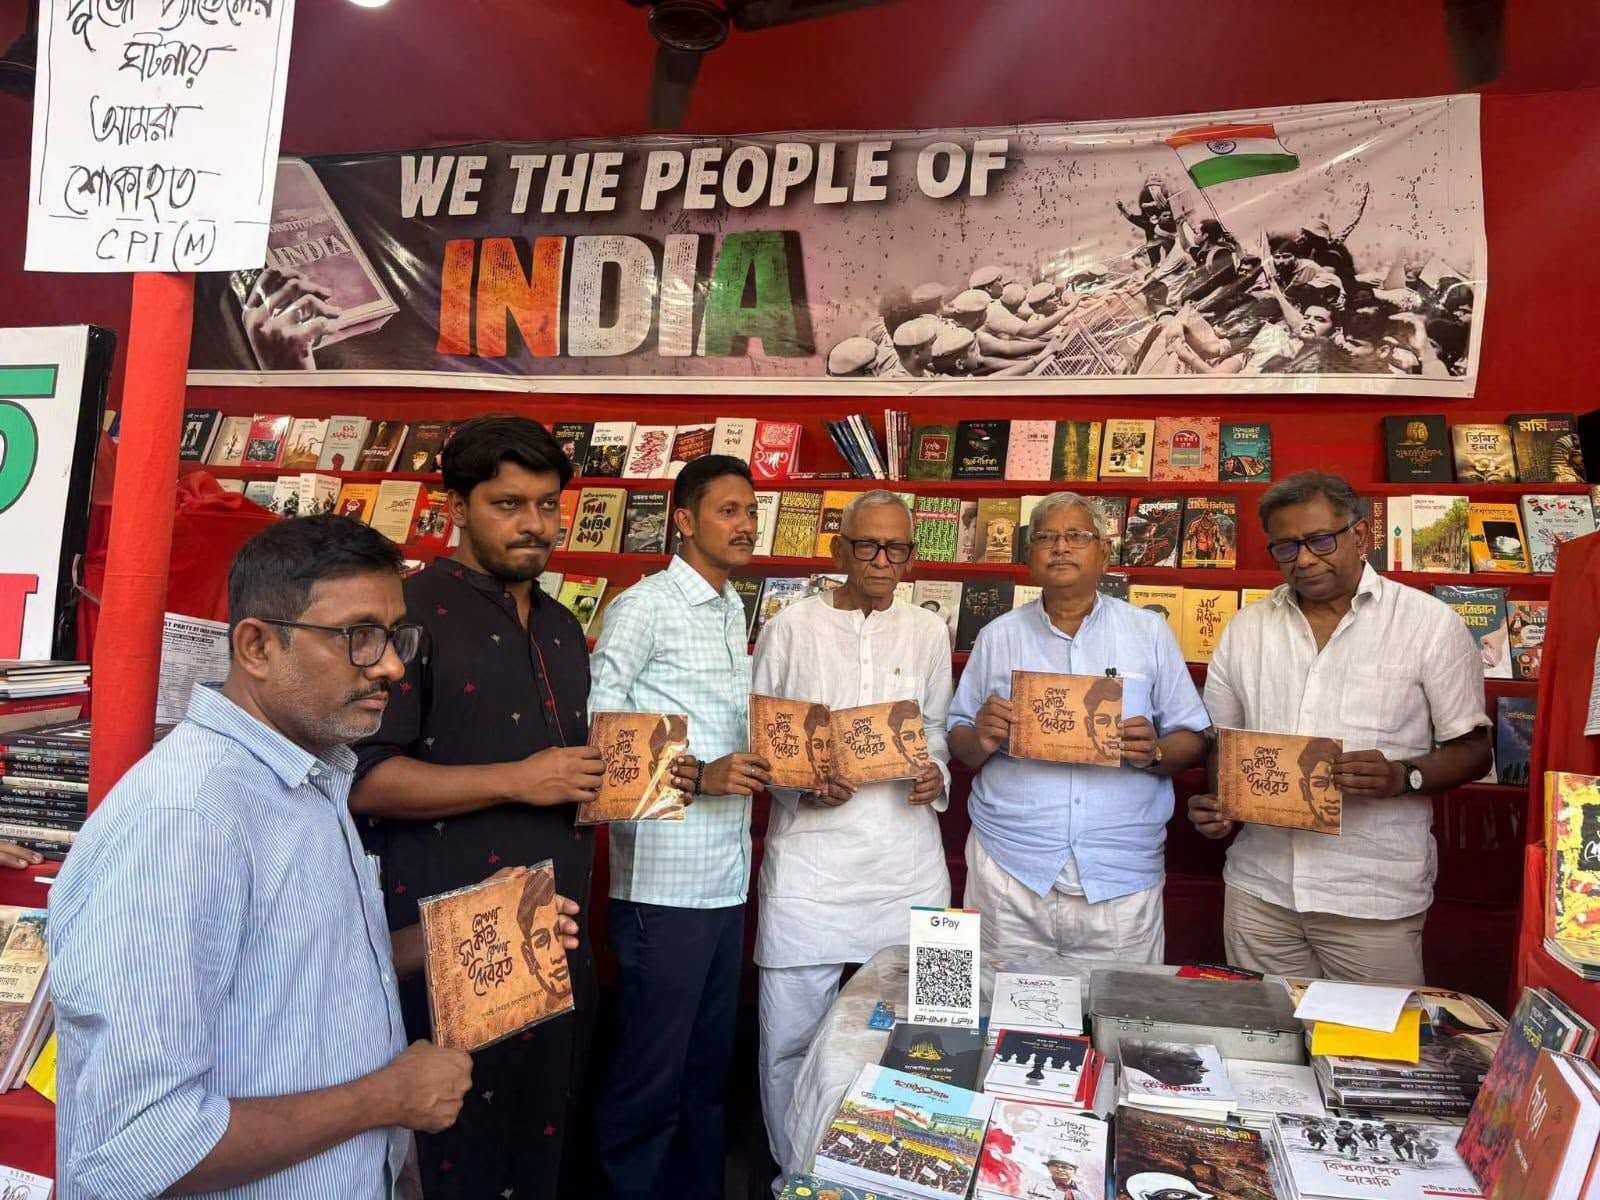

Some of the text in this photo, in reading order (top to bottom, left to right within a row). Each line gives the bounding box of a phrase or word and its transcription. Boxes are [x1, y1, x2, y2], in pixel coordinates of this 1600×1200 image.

[90, 95, 204, 145] আমরা
[400, 138, 1008, 218] WE THE PEOPLE OF
[437, 230, 812, 358] INDIA
[1465, 432, 1500, 443] তিমির
[930, 915, 960, 930] G Pay
[914, 1015, 972, 1025] BHIM UPI
[1323, 1159, 1401, 1176] বিশ্বকাপের
[1338, 1173, 1391, 1187] ডায়েরি
